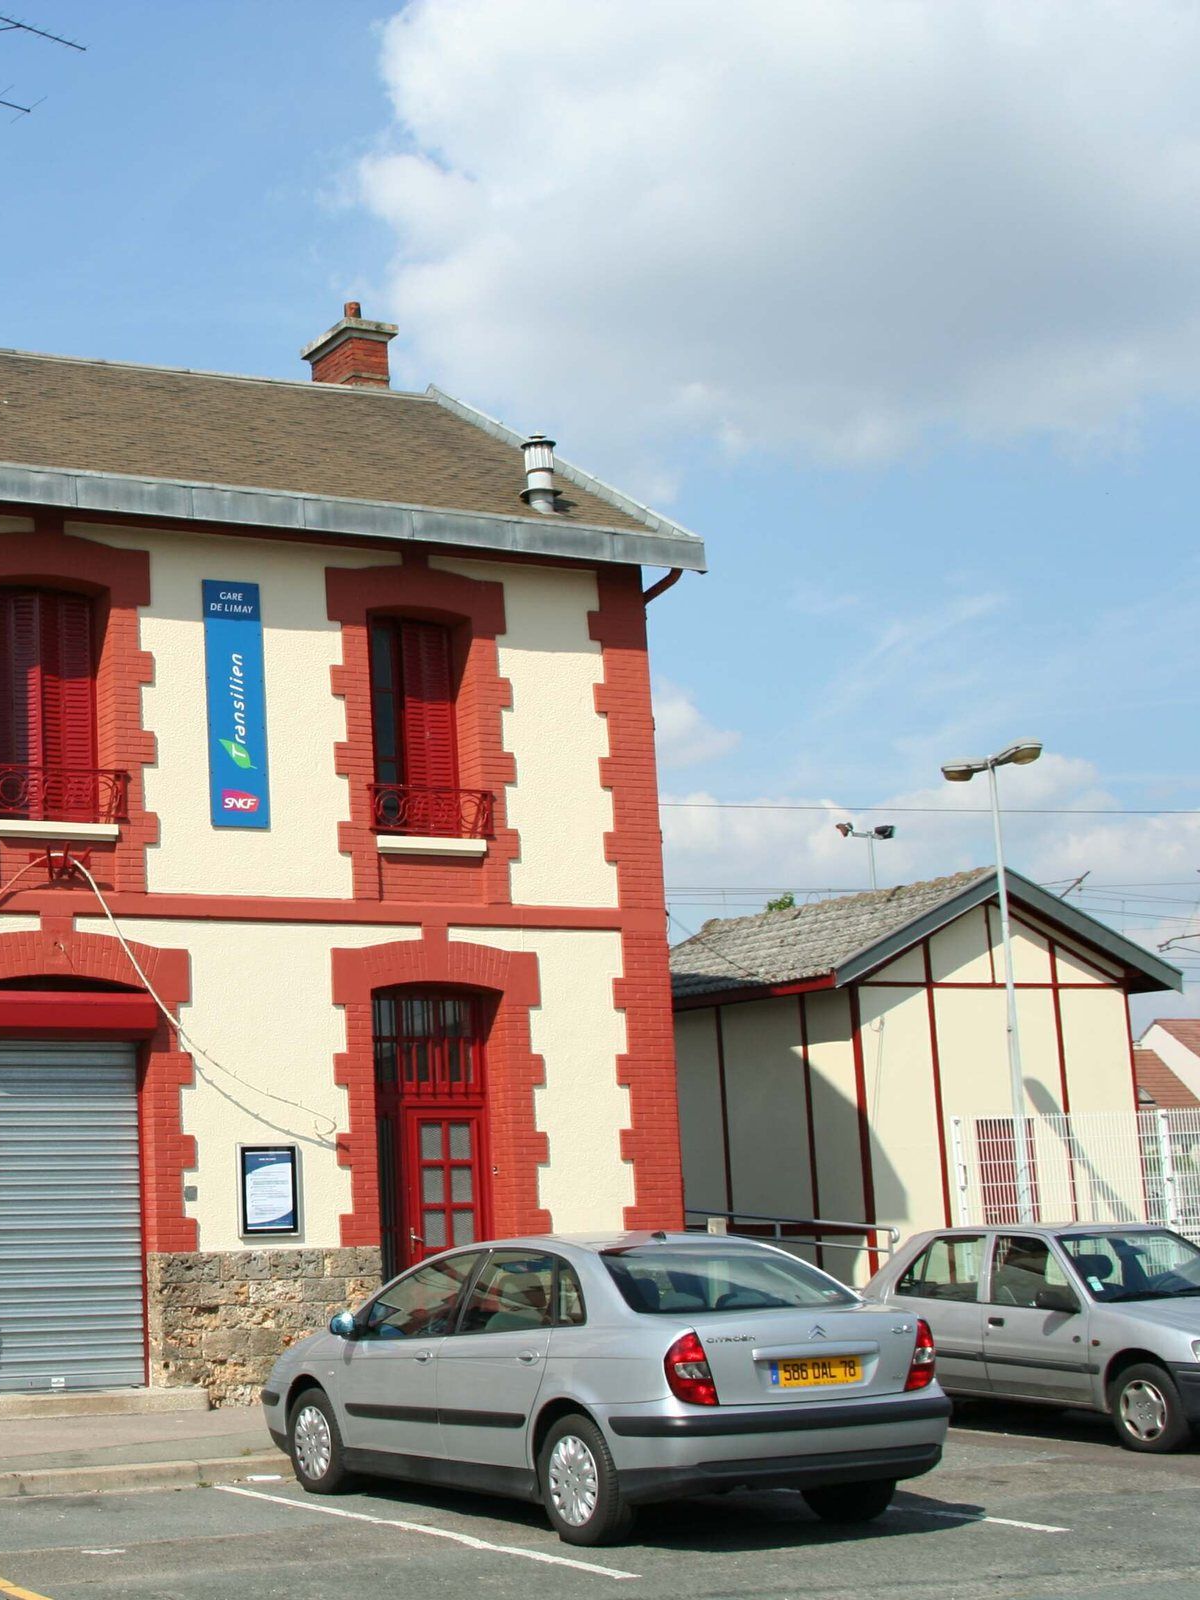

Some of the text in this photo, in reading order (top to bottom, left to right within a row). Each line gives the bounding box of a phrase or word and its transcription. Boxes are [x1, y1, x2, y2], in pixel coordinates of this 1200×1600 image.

[219, 591, 243, 601] GARE
[210, 602, 253, 614] DE LIMAY
[229, 653, 247, 758] Transilien
[223, 797, 257, 809] SNCF
[783, 1360, 856, 1381] 586 DAL 78
